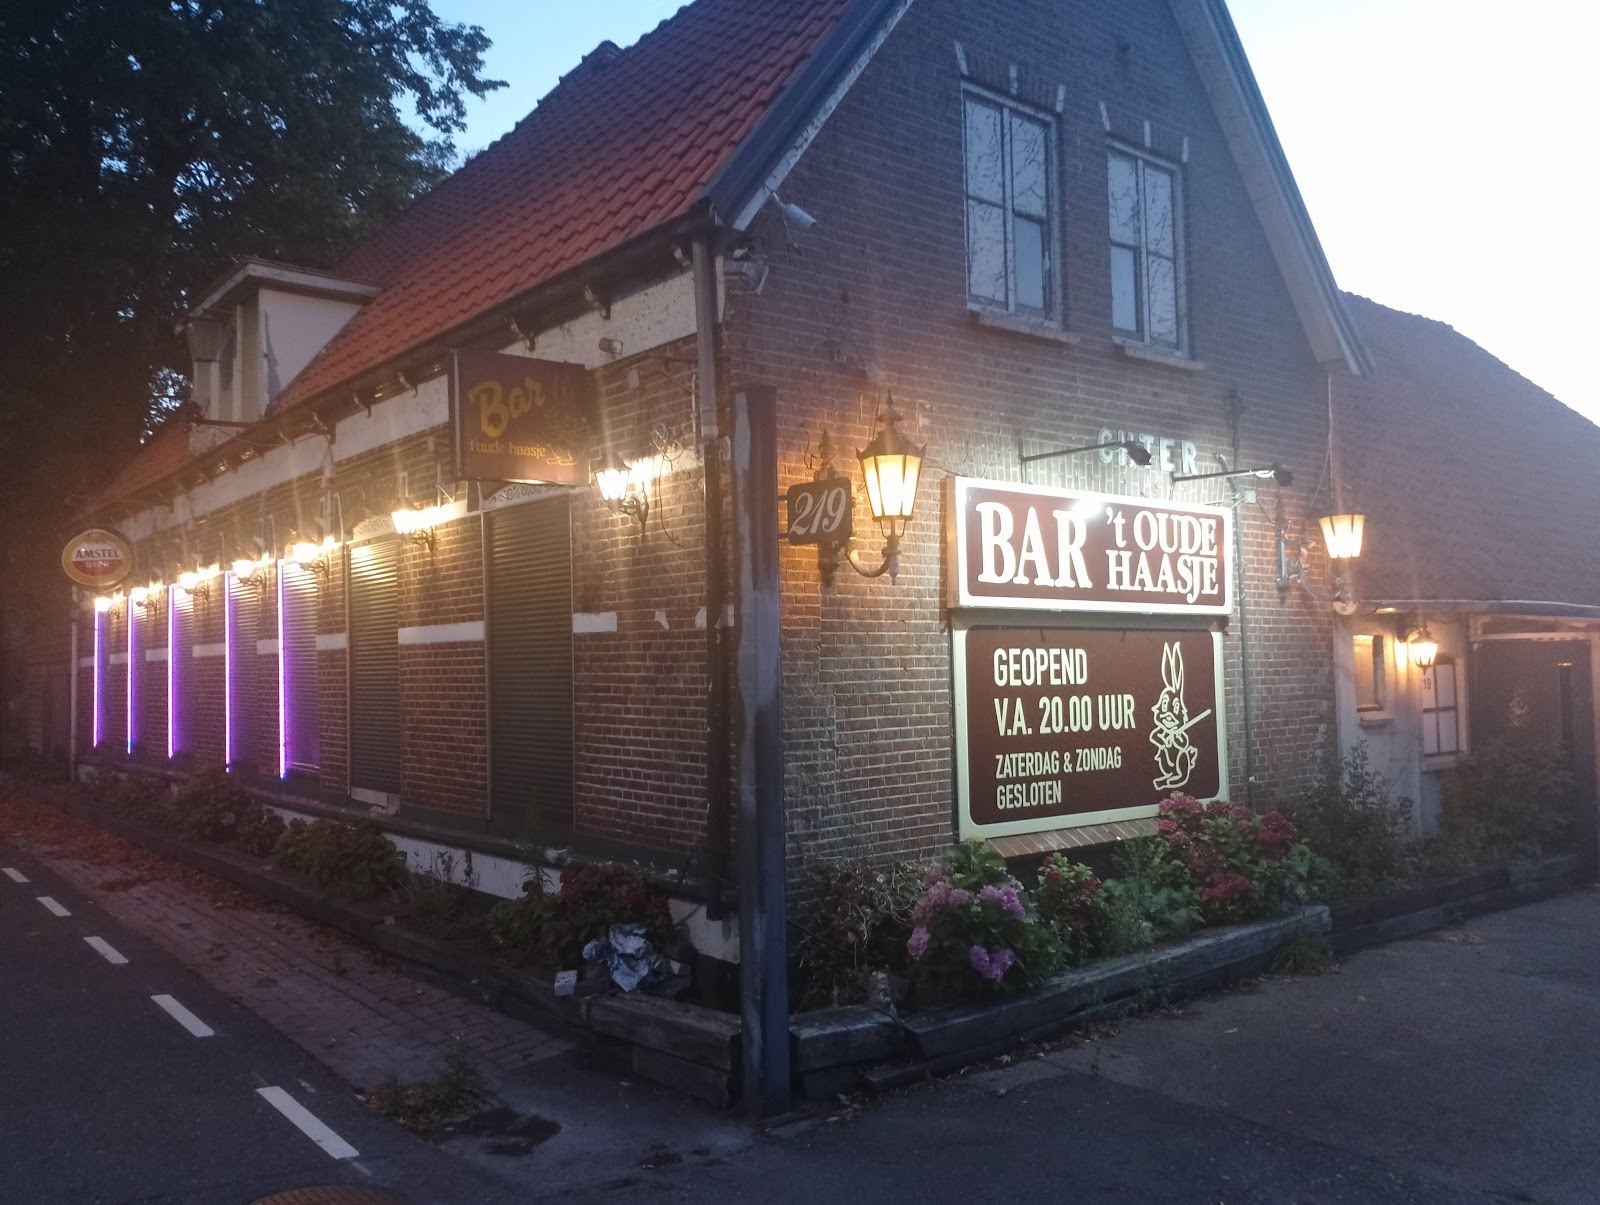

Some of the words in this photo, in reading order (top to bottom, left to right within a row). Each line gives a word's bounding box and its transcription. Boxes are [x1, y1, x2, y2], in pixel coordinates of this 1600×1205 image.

[468, 376, 545, 438] Bar
[508, 441, 547, 459] haasje
[790, 487, 846, 535] 219
[75, 548, 119, 558] AMSTEL
[976, 501, 1092, 588] BAR
[1133, 510, 1217, 555] OUDE
[1105, 549, 1219, 603] HAASJE
[993, 647, 1088, 686] GEOPEND
[994, 697, 1033, 736] V.A.
[1039, 695, 1092, 734] 20.00
[1098, 694, 1136, 731] UUR
[995, 750, 1060, 779] ZATERDAG
[1063, 757, 1073, 773] &
[1075, 746, 1122, 772] ZONDAG
[996, 780, 1062, 810] GESLOTEN
